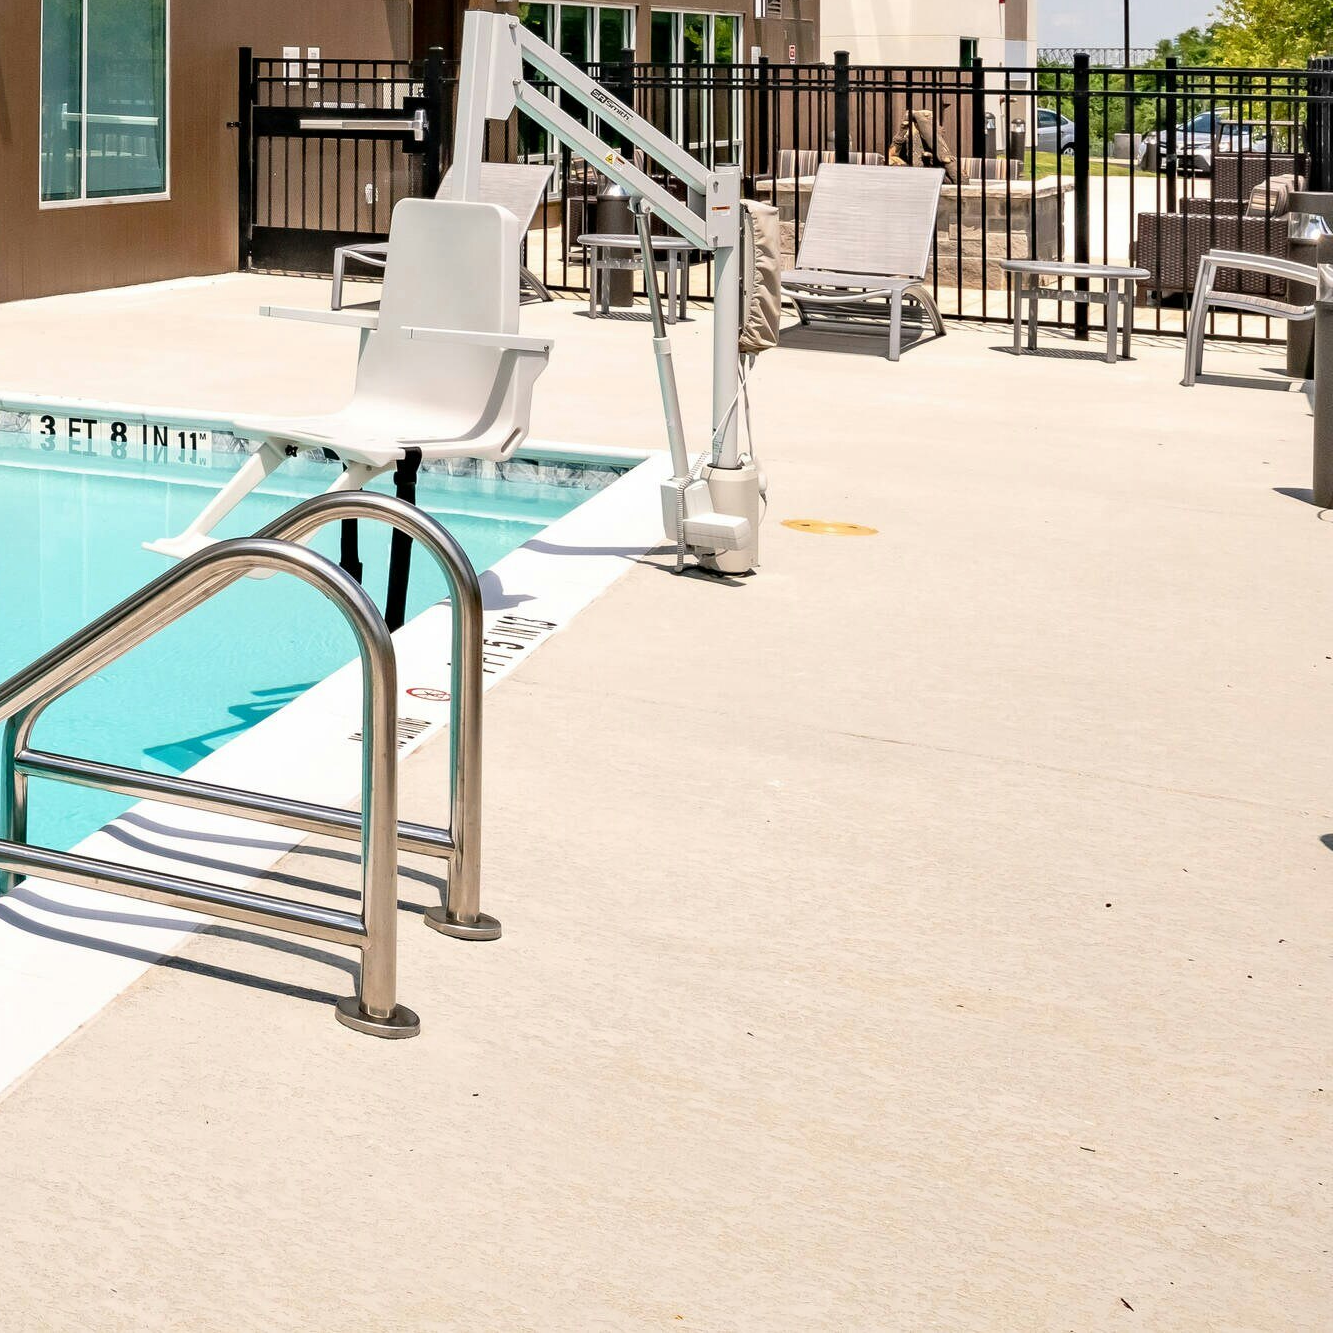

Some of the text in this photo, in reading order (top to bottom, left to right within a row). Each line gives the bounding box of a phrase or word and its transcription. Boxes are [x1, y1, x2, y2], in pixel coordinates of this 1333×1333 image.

[591, 89, 632, 121] SR Smith
[40, 415, 56, 436] 3
[69, 418, 97, 439] FT
[110, 422, 128, 442] 8
[142, 424, 167, 447] IN
